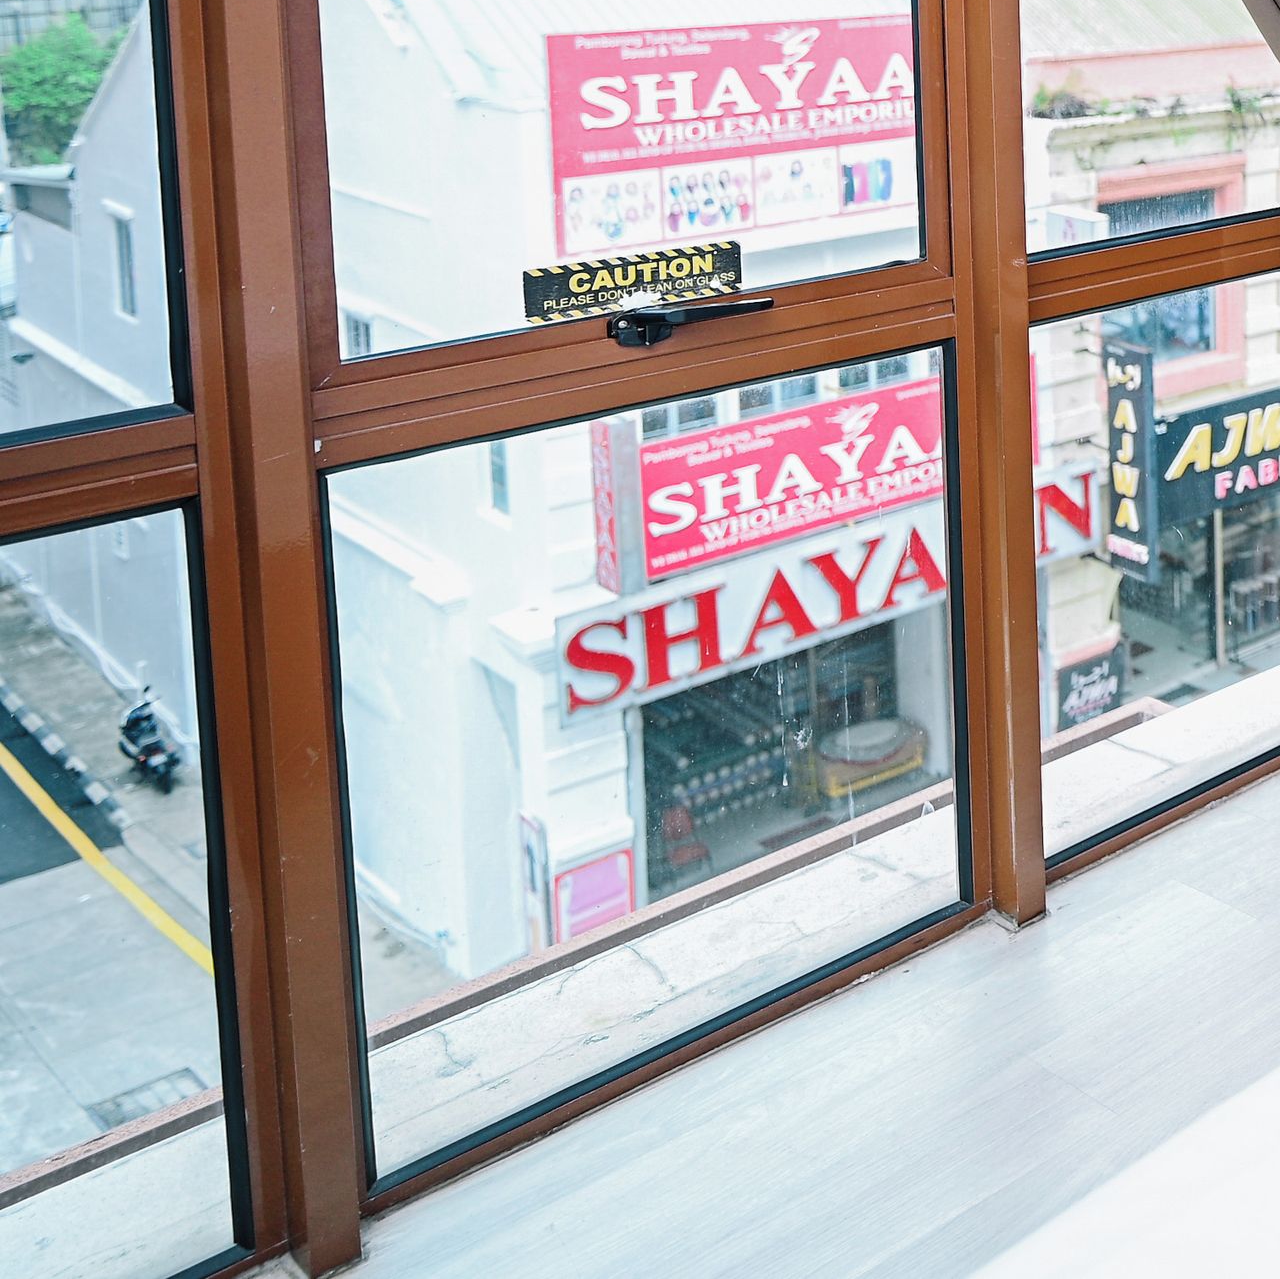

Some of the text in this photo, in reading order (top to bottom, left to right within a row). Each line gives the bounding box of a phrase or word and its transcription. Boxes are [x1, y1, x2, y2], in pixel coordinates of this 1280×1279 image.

[633, 111, 802, 147] WHOLESALE
[543, 293, 595, 311] PLEASE
[675, 278, 694, 289] ON
[696, 271, 736, 286] GLASS
[568, 254, 714, 294] CAUTION
[647, 424, 943, 538] SHAYA
[700, 481, 863, 544] WHOLESALE
